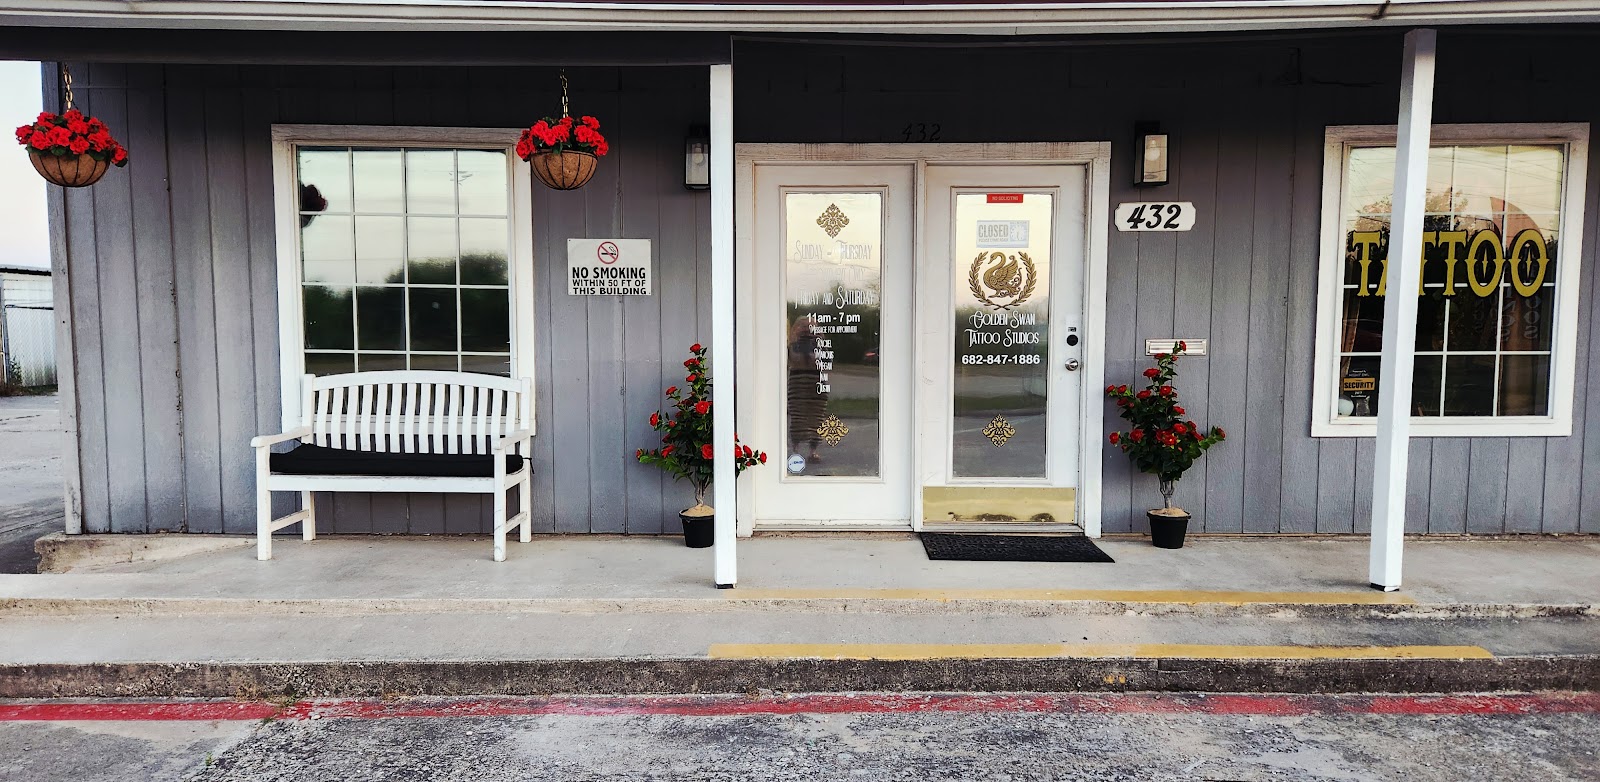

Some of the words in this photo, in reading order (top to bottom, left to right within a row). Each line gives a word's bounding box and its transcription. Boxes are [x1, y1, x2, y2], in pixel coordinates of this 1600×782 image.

[902, 122, 941, 142] 432
[1126, 204, 1182, 229] 432
[978, 224, 1009, 238] CLOSED
[572, 267, 589, 279] NO
[593, 267, 646, 279] SMOKING
[572, 279, 605, 287] WITHIN
[608, 279, 618, 287] 50
[621, 279, 632, 287] FT
[634, 279, 646, 287] OF
[573, 287, 596, 295] THIS
[599, 287, 647, 295] BUILDING
[806, 312, 832, 323] 11am
[838, 312, 845, 323] 7
[846, 314, 861, 325] pm
[968, 310, 1008, 329] GOLDEN
[1010, 310, 1036, 329] SWAN
[964, 328, 1001, 348] TATTOO
[1002, 328, 1040, 348] STUDIOS
[961, 354, 1041, 365] 682-847-1886
